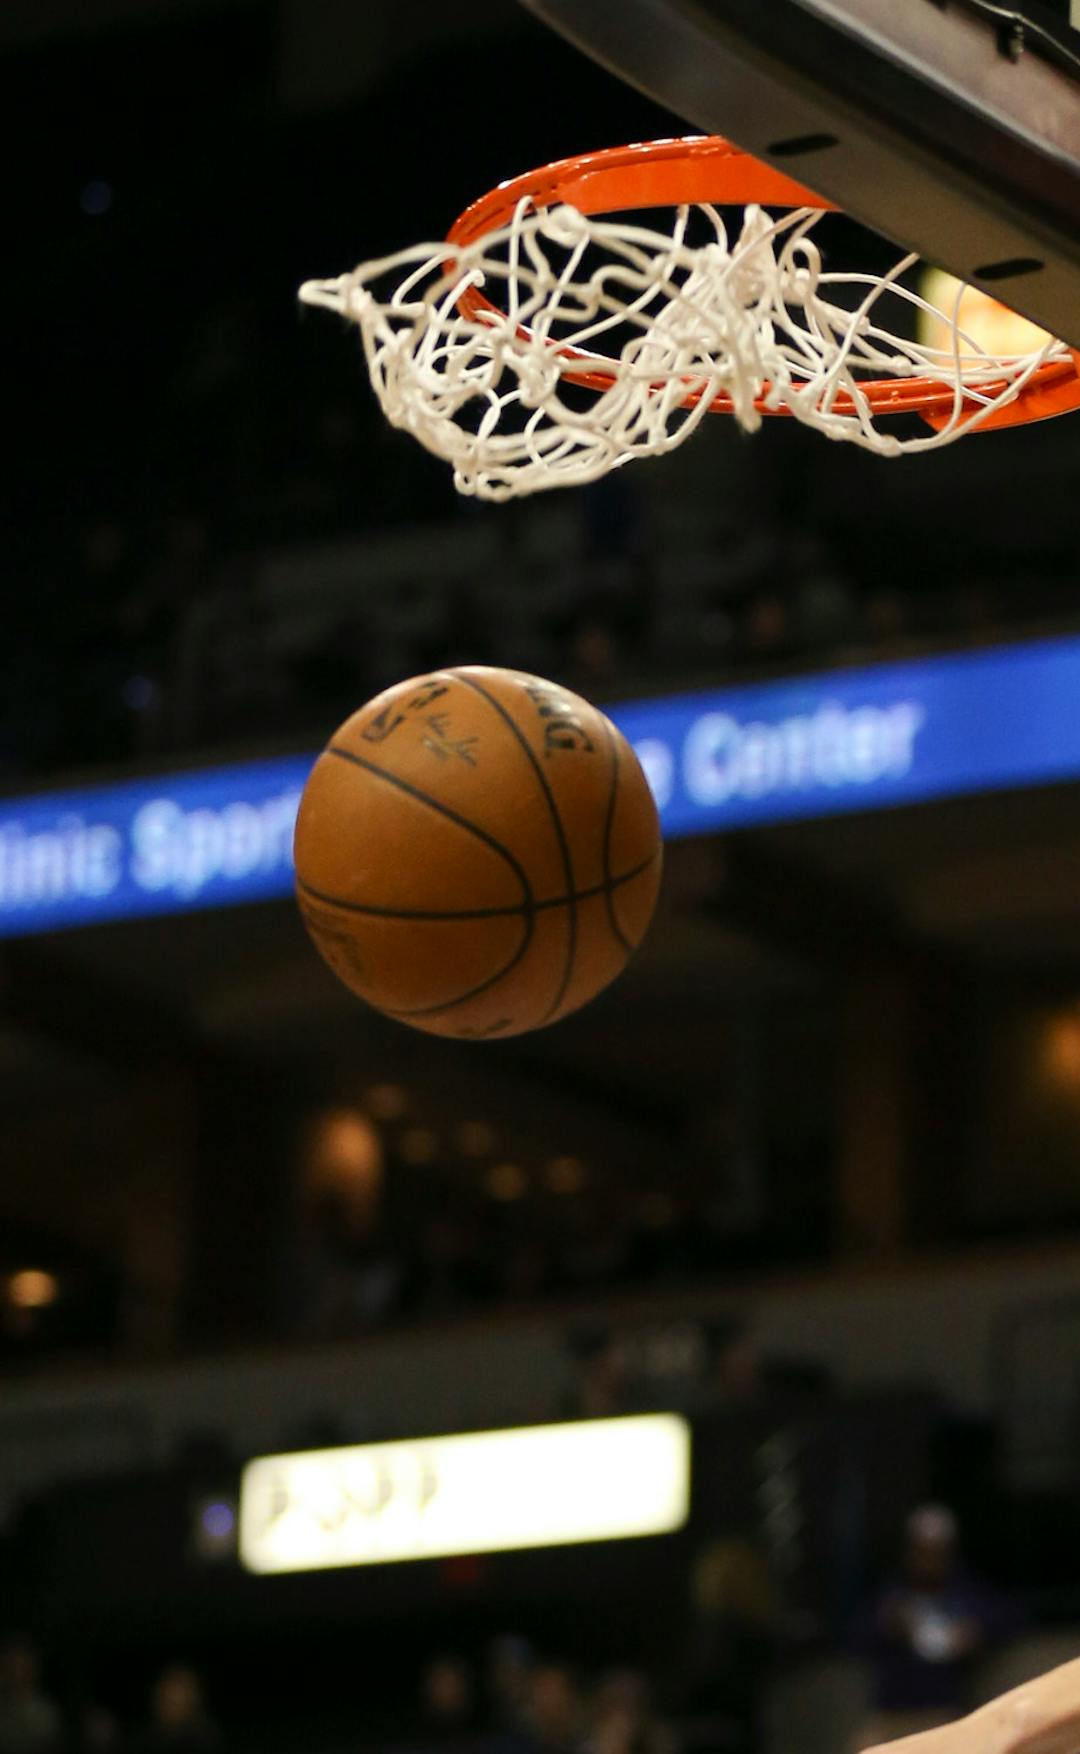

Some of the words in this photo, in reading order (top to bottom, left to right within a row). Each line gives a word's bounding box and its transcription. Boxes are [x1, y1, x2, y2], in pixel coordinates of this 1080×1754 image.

[0, 820, 121, 906] inic
[131, 790, 302, 900] Spor
[684, 699, 924, 805] Center
